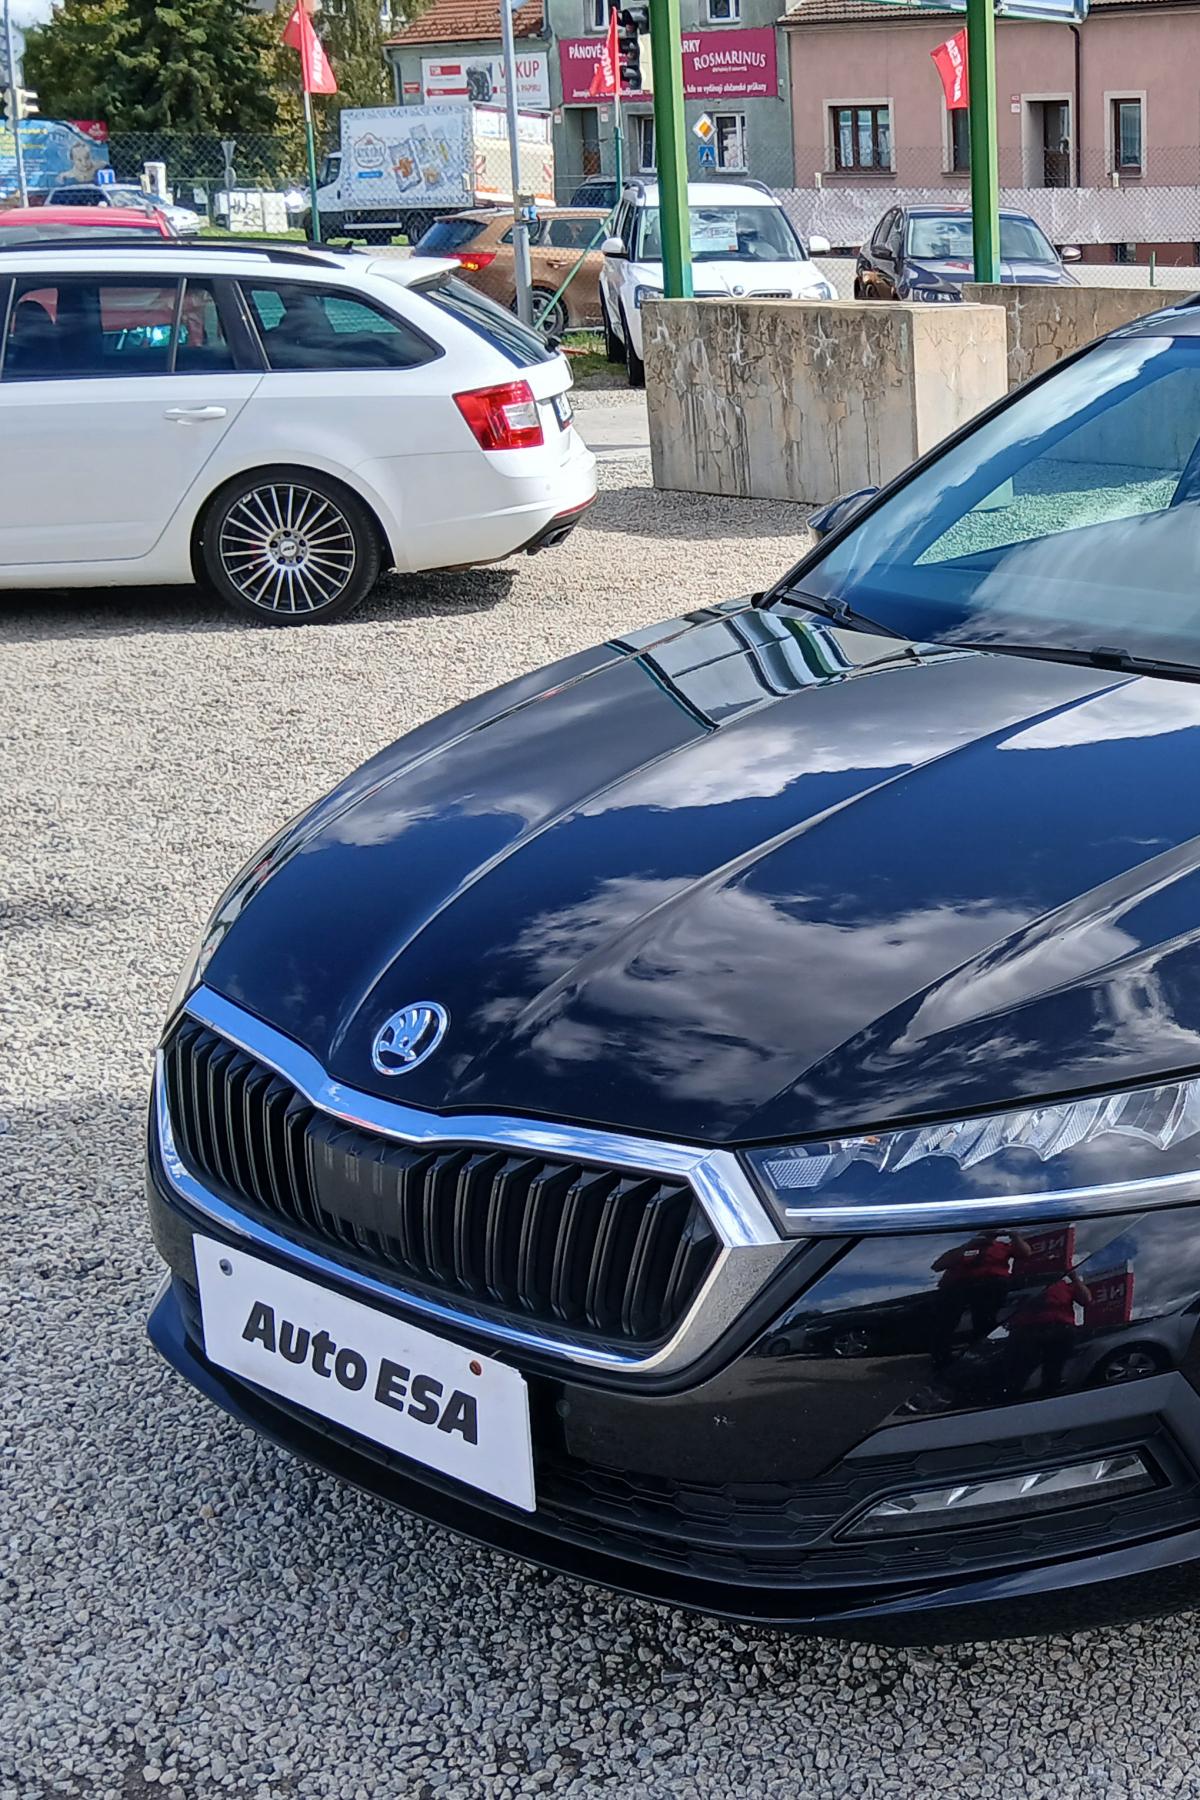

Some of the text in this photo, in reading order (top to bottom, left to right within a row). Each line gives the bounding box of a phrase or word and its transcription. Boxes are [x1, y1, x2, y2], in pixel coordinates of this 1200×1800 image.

[499, 60, 540, 79] VKUP
[693, 50, 767, 71] ROSMARINUS
[241, 1299, 478, 1446] Auto ESA
